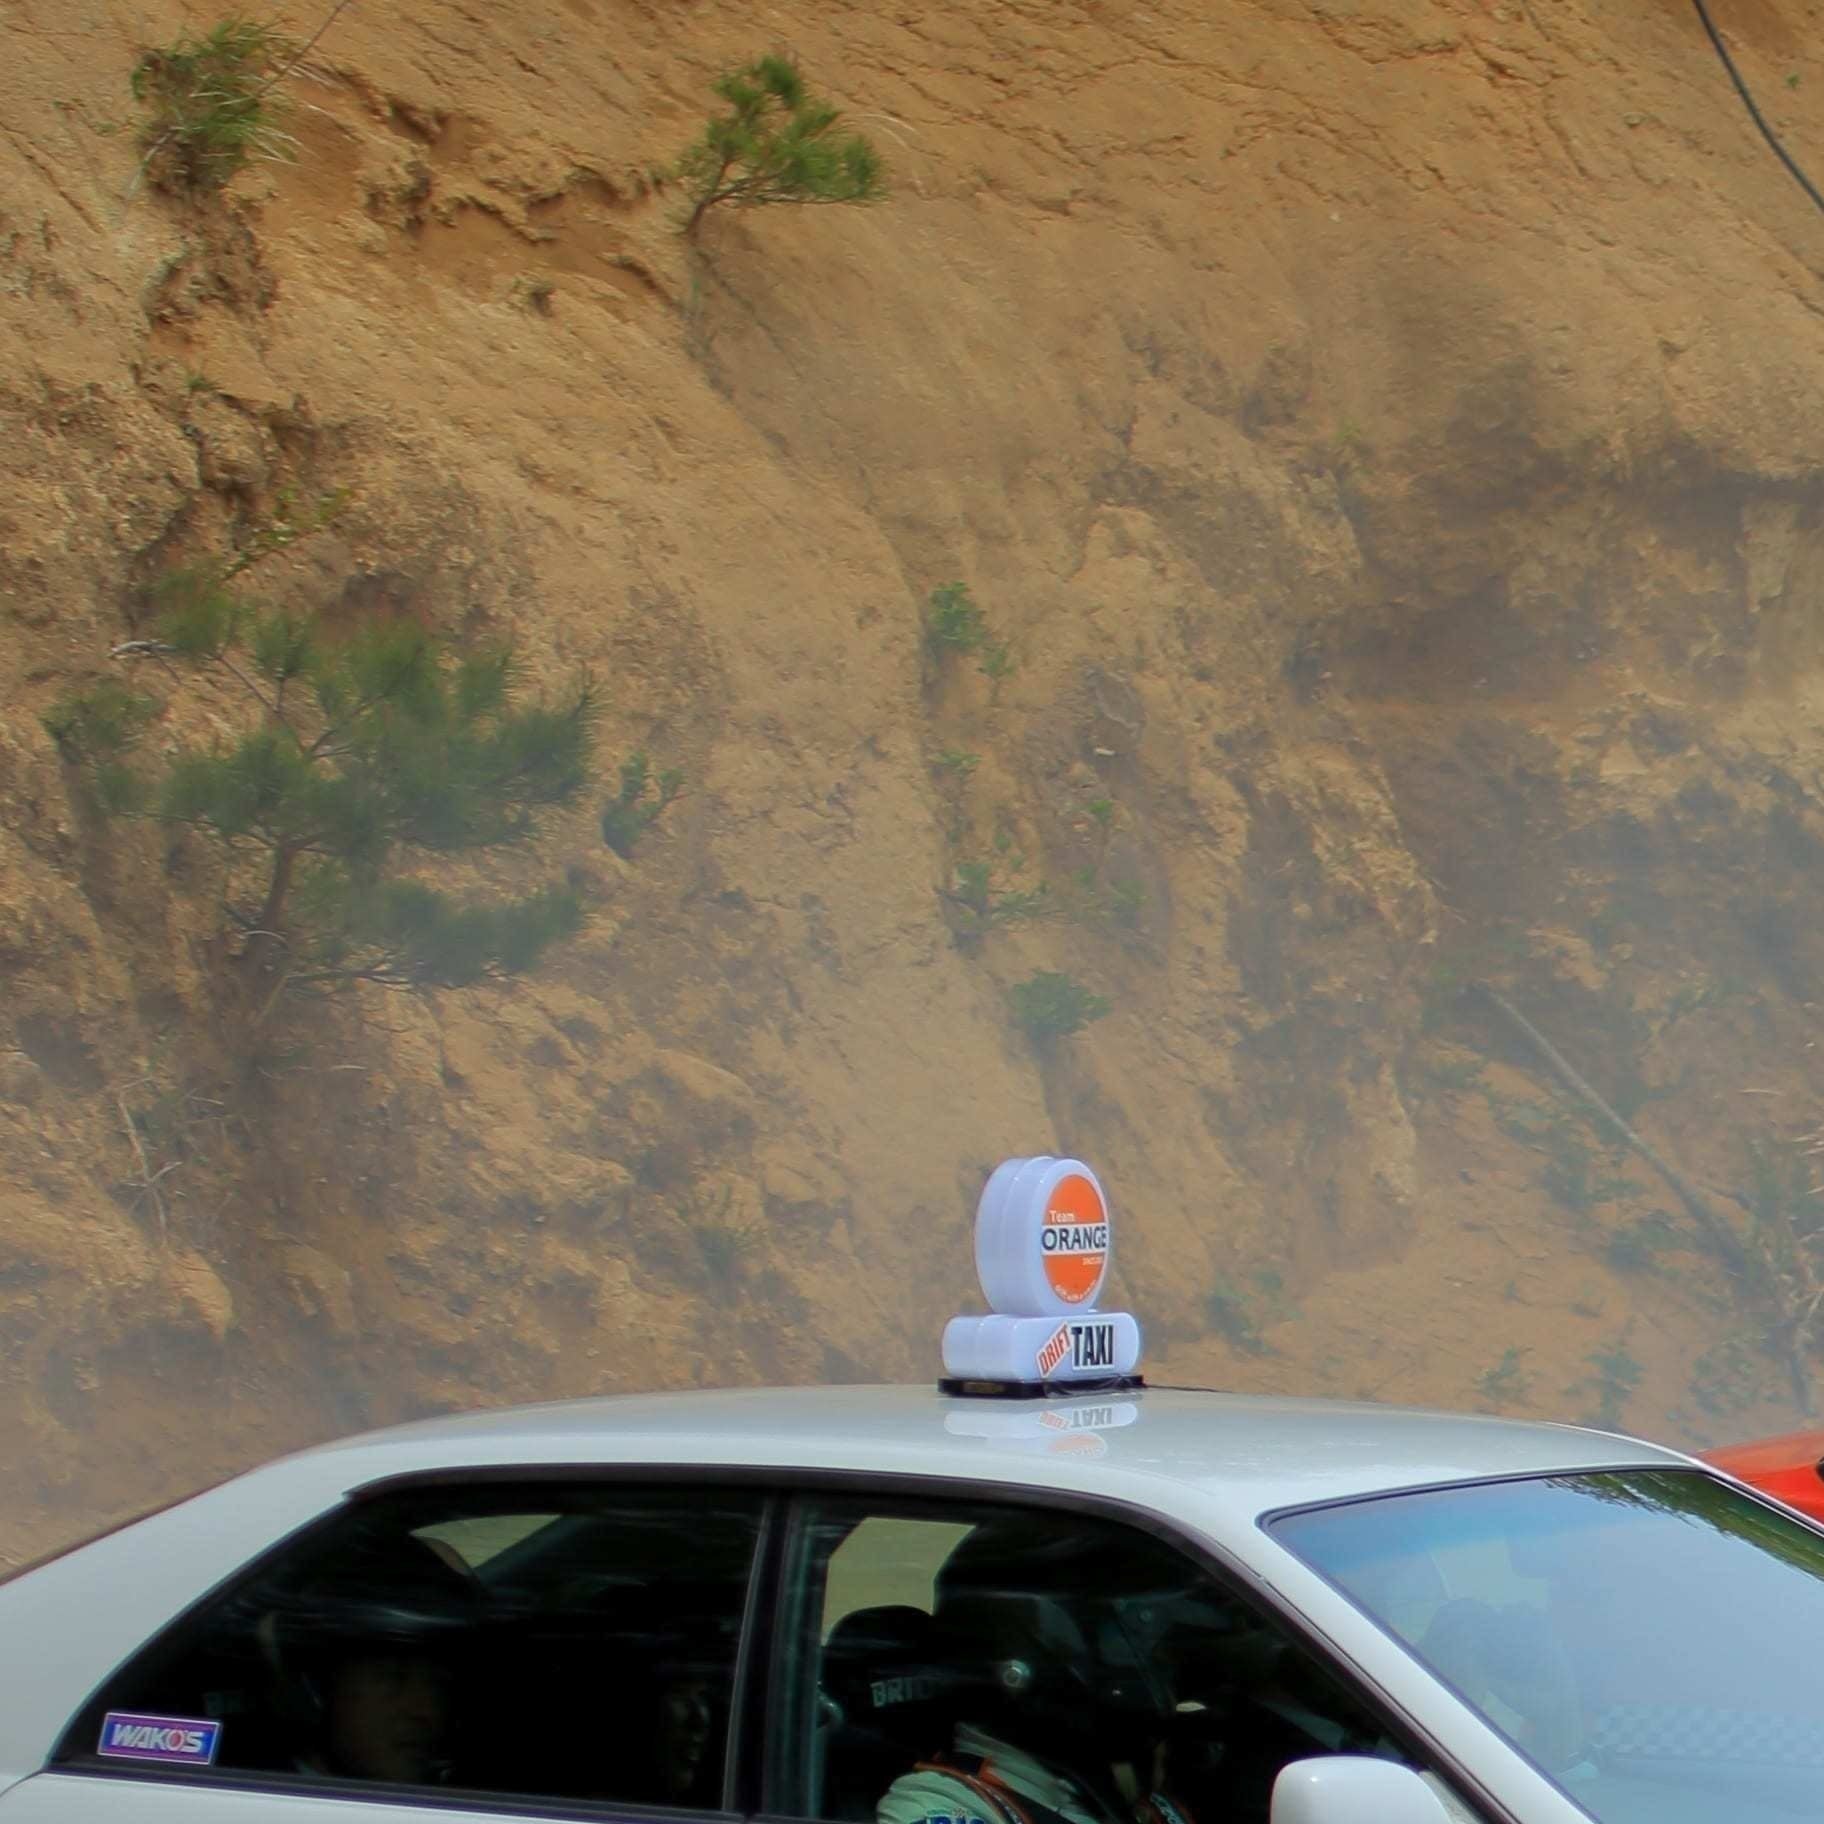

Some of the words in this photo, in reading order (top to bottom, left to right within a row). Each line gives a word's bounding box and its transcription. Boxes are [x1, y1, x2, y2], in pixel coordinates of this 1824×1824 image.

[1042, 1226, 1107, 1251] ORANGE
[1038, 1323, 1071, 1375] DRIFT
[1071, 1324, 1114, 1367] TAXI
